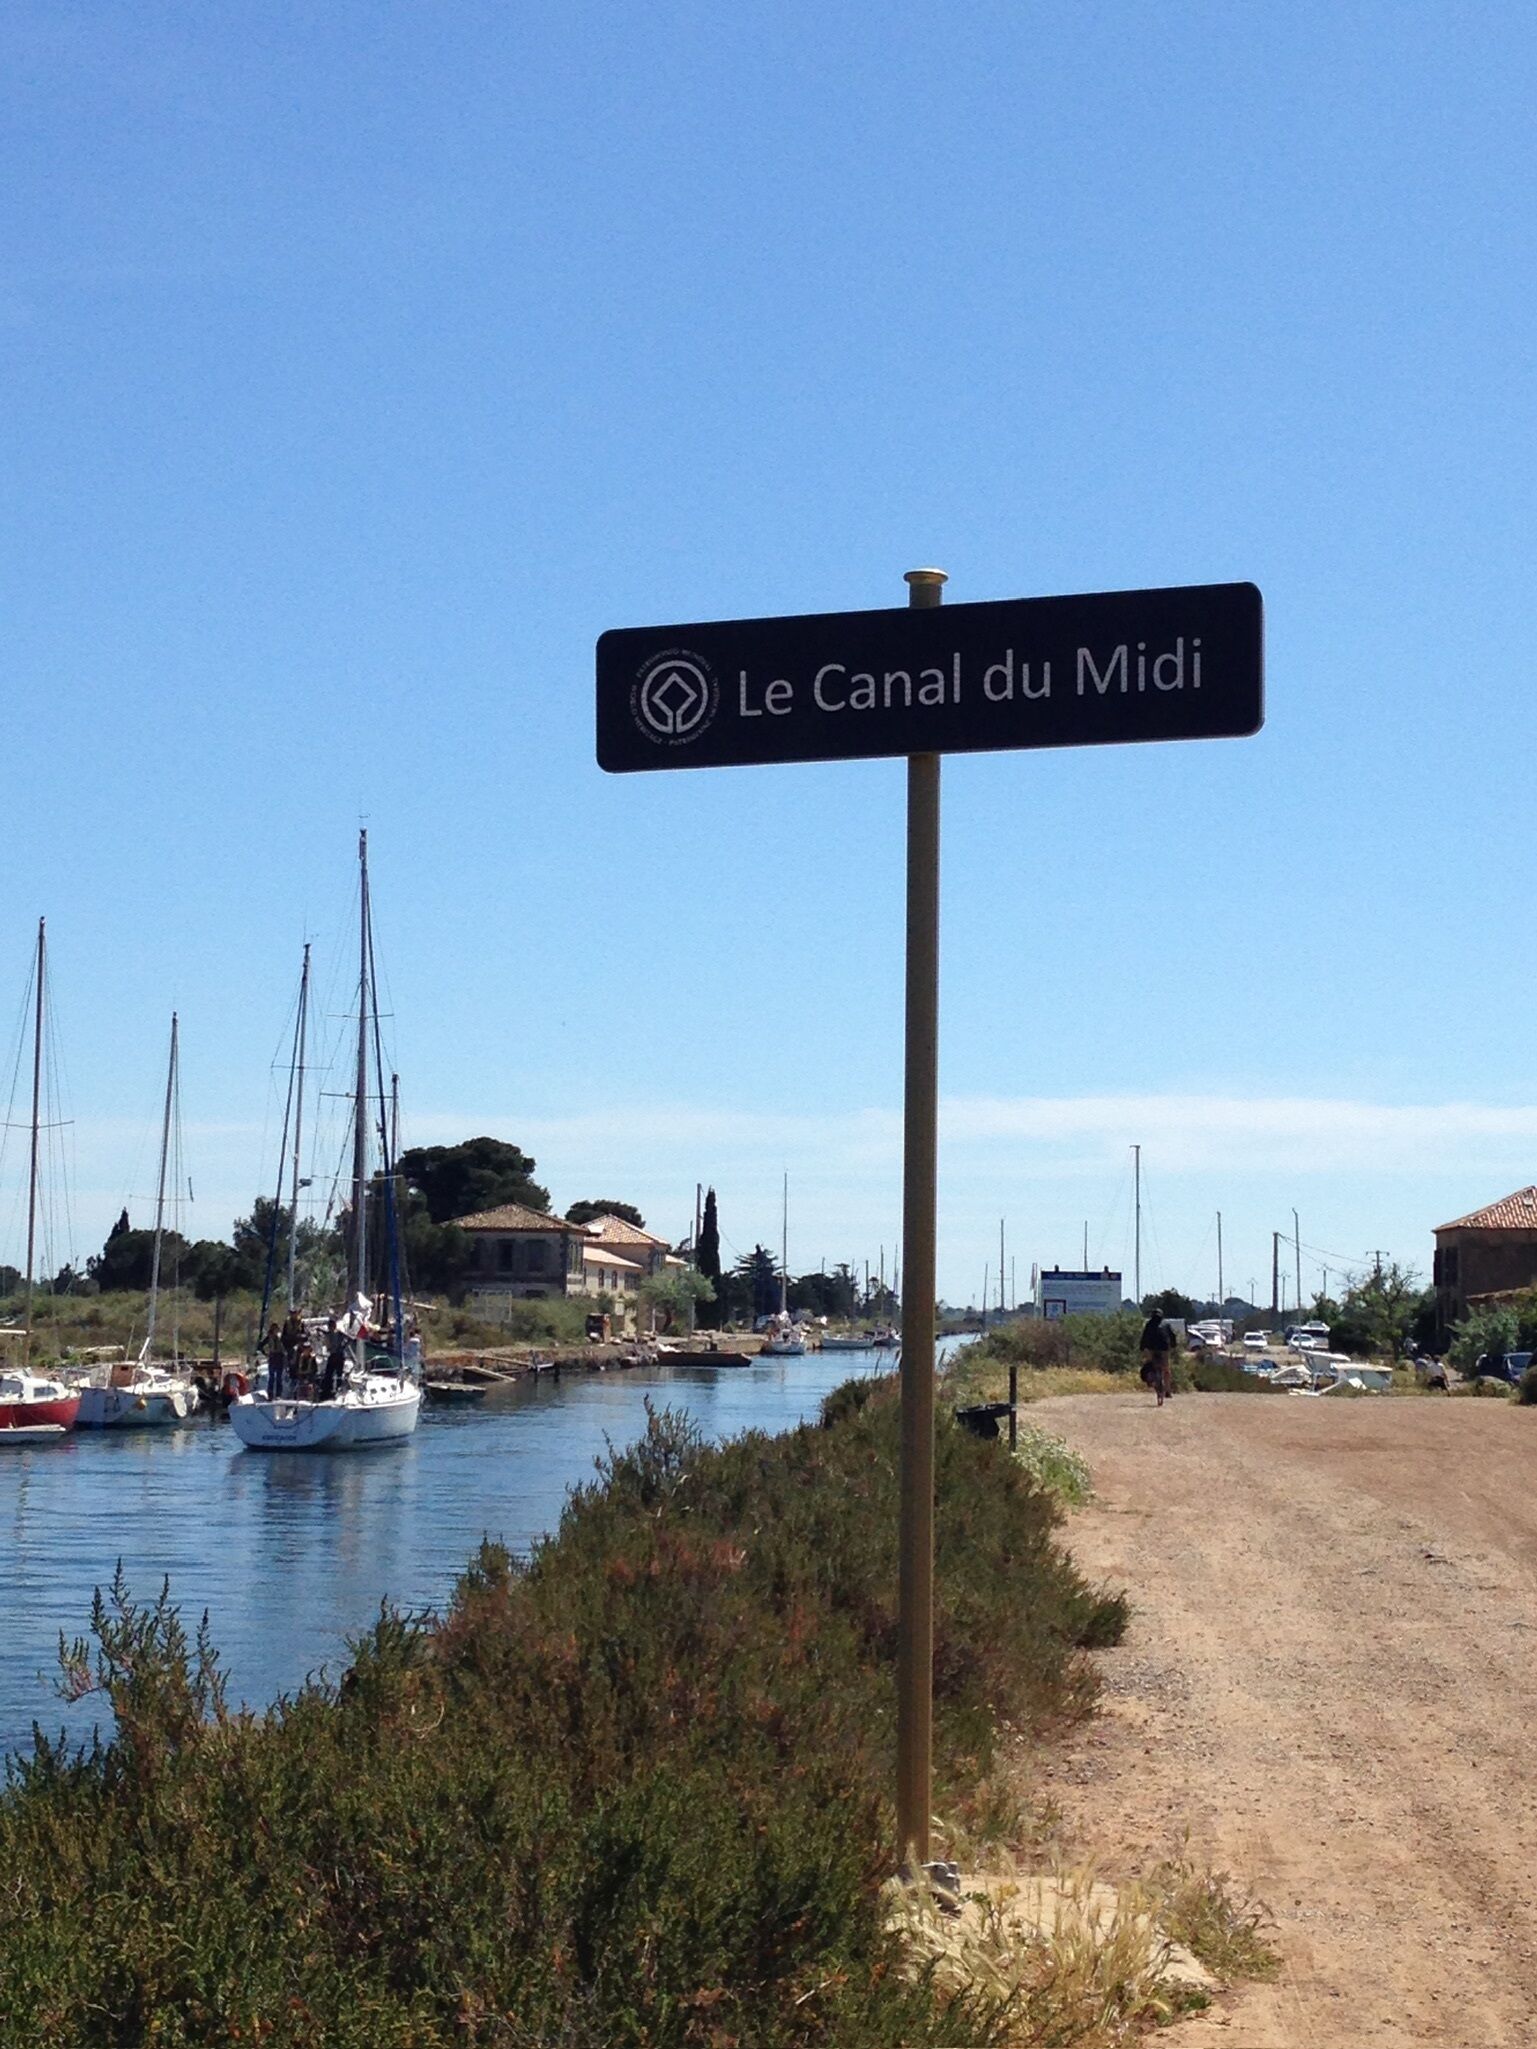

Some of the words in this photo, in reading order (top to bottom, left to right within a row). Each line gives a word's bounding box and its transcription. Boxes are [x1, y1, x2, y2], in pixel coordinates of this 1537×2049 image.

[739, 670, 793, 716] Le
[813, 652, 961, 711] Canal
[983, 648, 1051, 701] du
[1077, 636, 1201, 695] Midi
